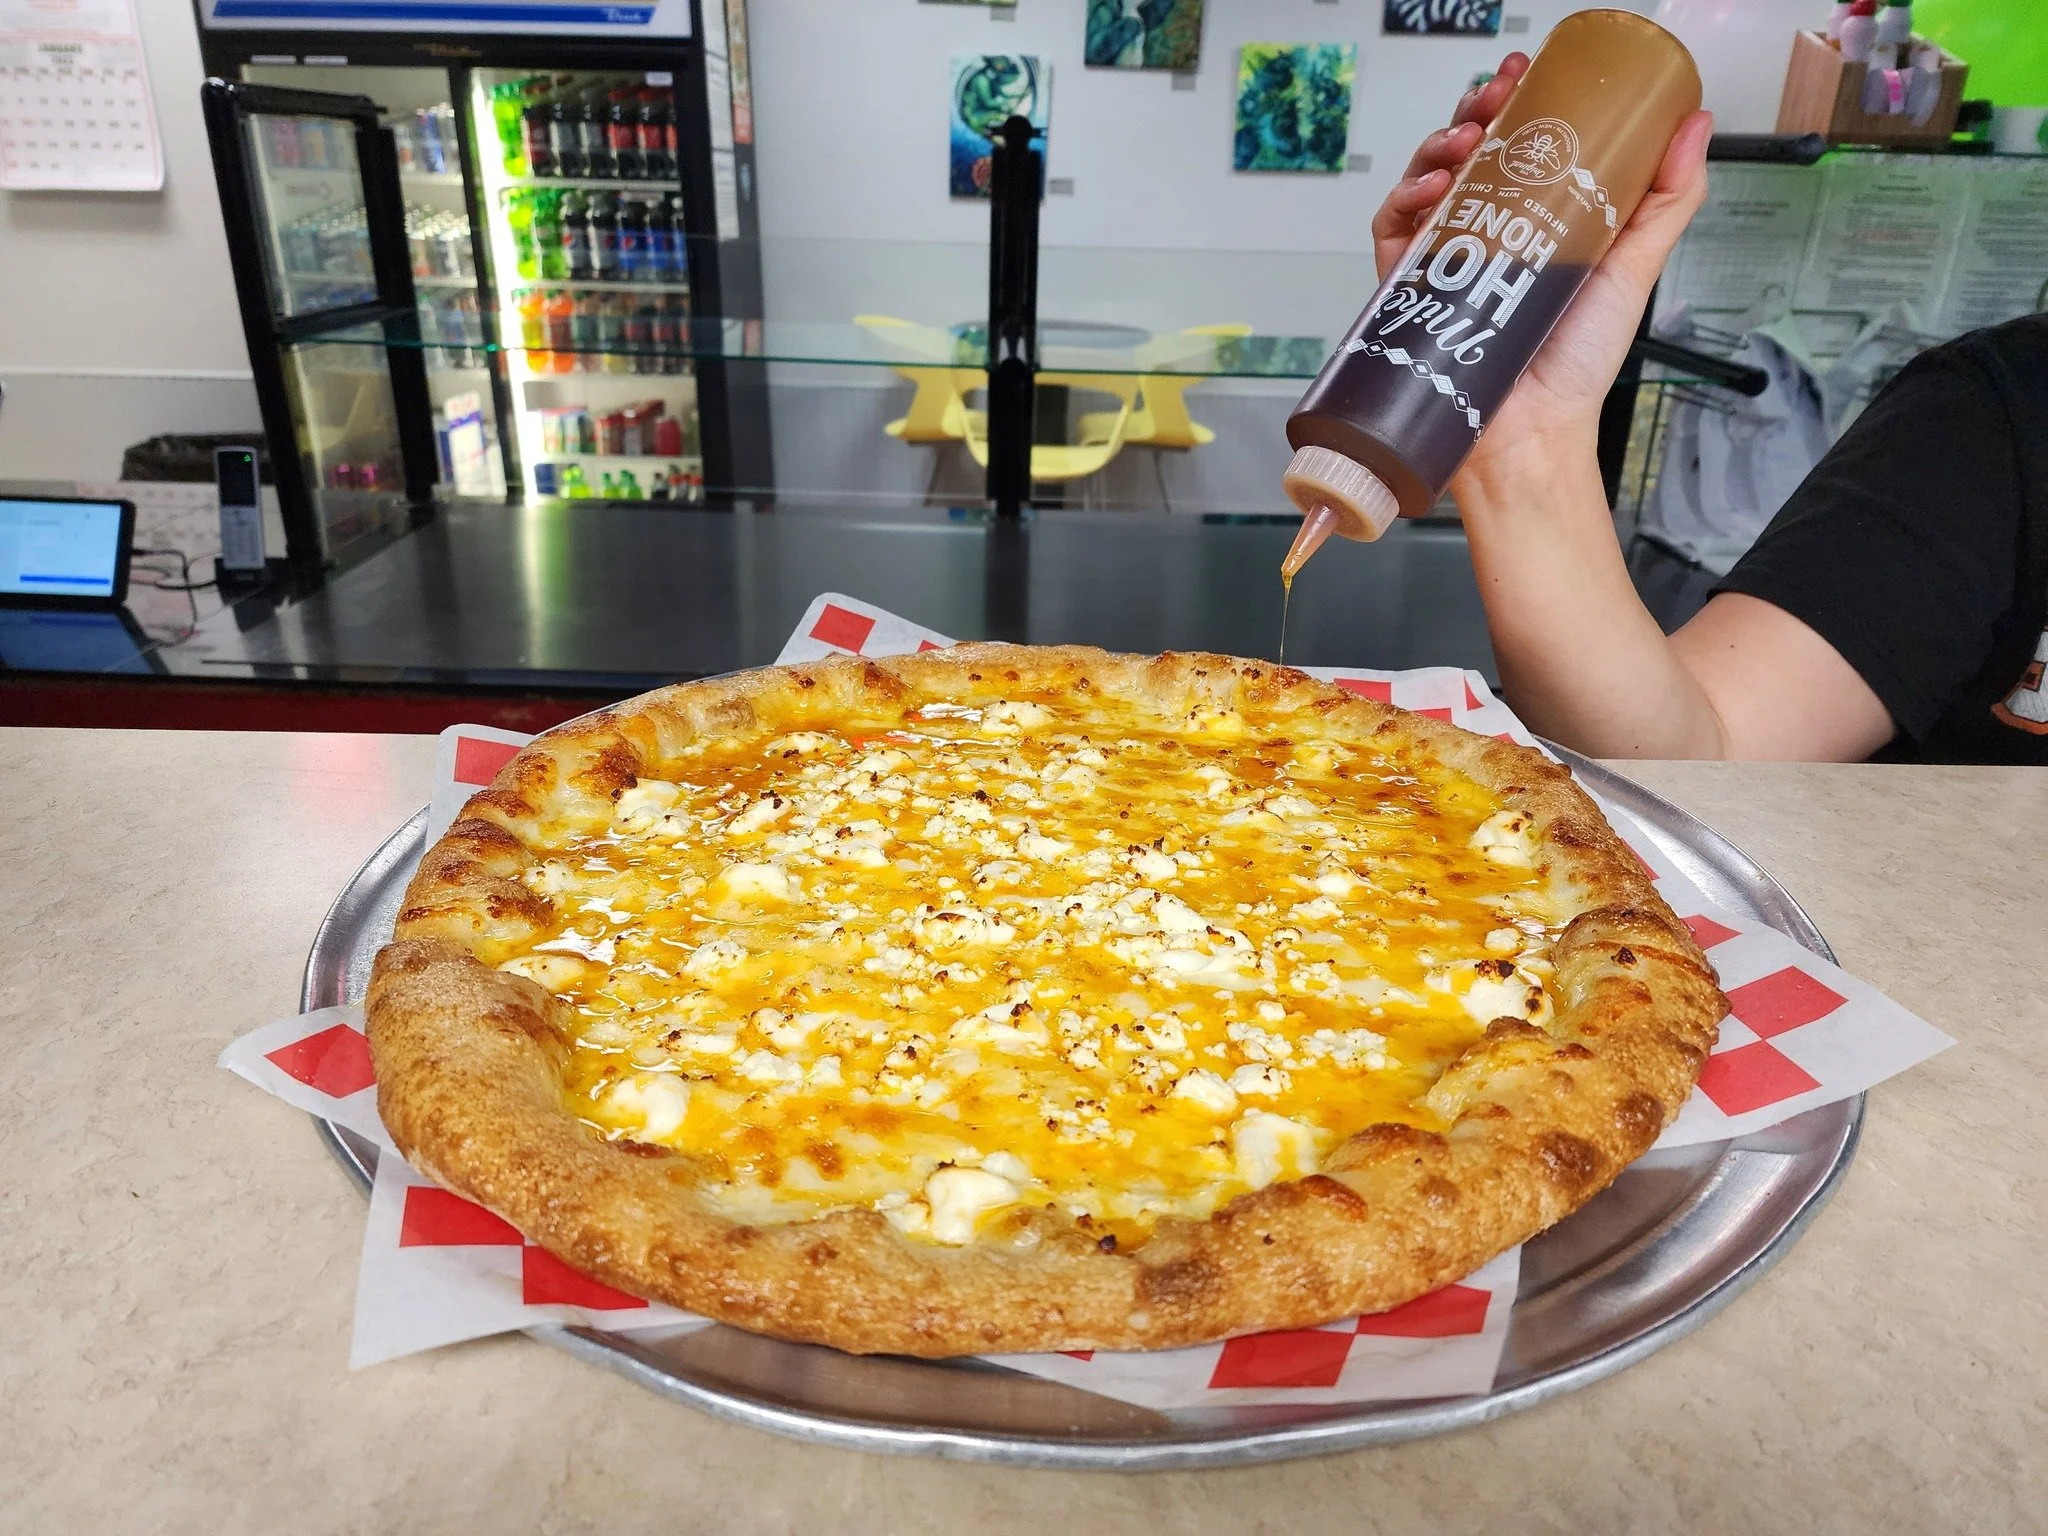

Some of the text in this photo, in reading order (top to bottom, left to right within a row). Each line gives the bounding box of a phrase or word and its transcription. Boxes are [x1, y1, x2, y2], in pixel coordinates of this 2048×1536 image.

[1522, 126, 1537, 136] YORK
[1508, 160, 1545, 178] Original
[1430, 198, 1558, 274] HONEY
[1524, 198, 1569, 237] INFUSED
[1396, 230, 1537, 330] HOT
